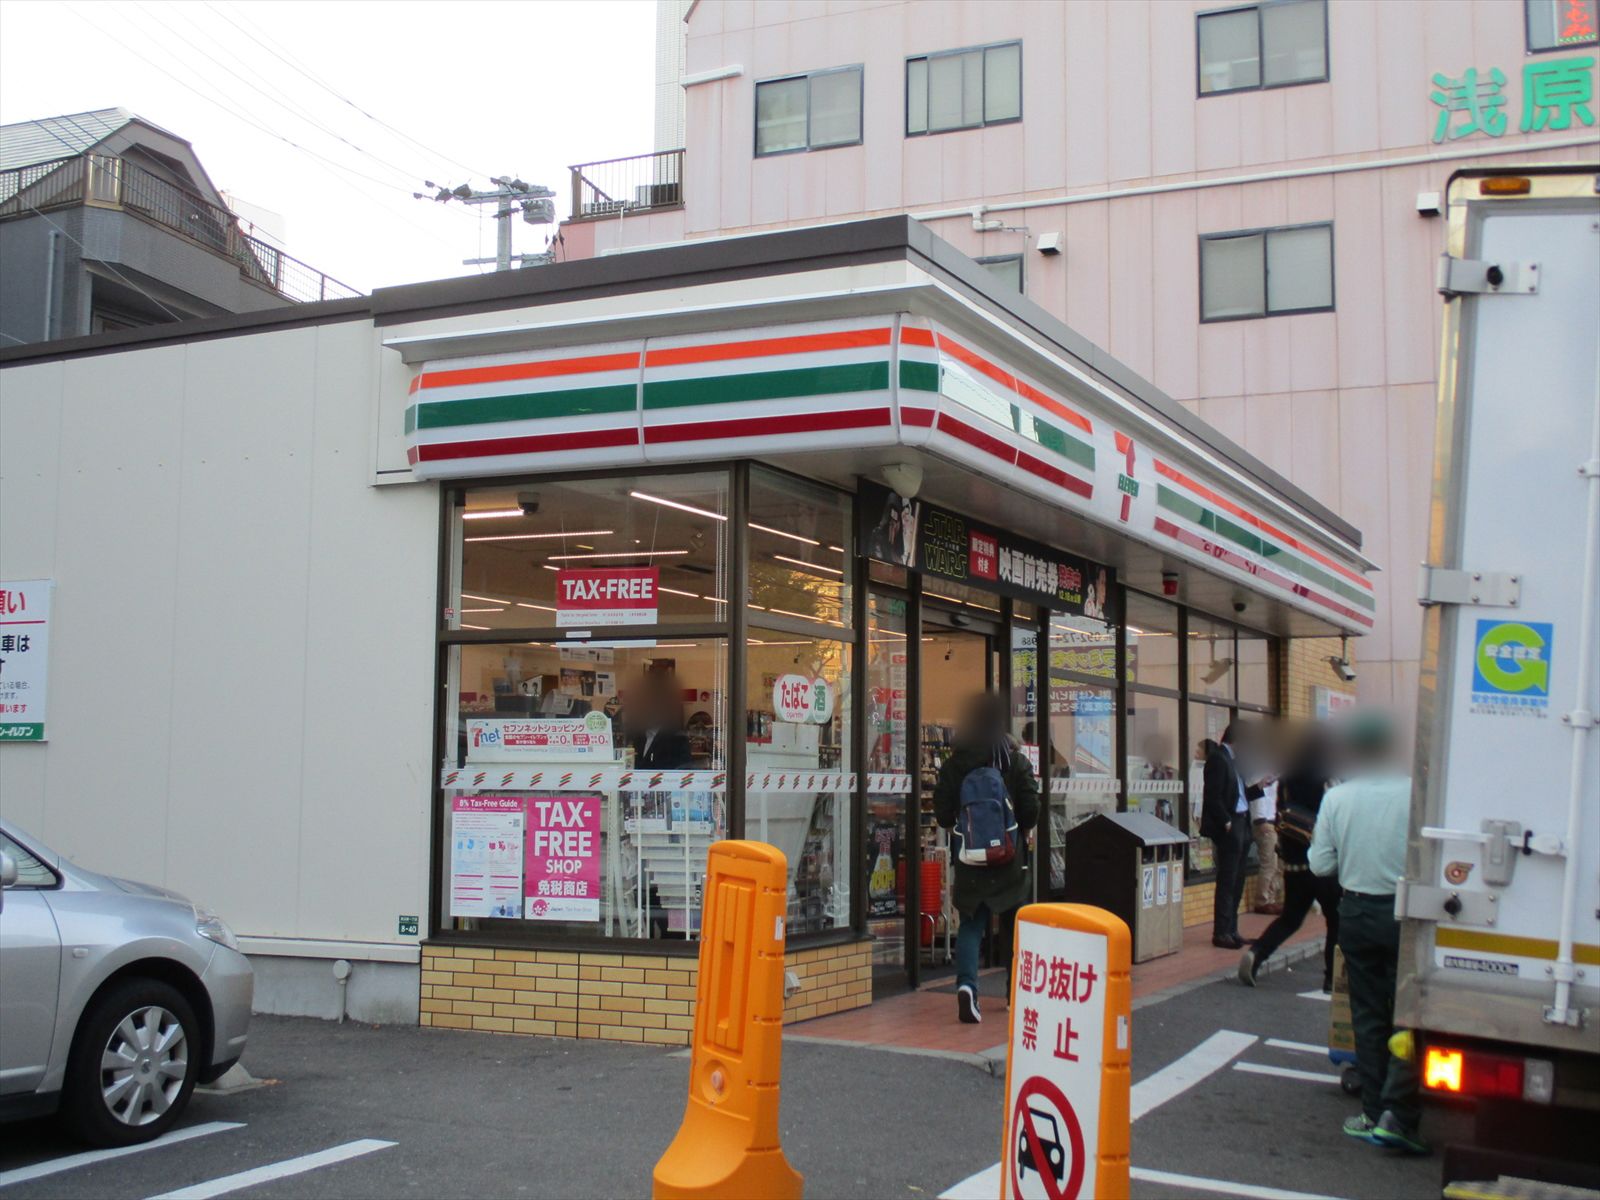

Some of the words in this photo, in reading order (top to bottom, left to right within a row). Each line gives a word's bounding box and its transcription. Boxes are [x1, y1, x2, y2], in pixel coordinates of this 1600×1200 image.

[1429, 56, 1595, 145] 浅原
[924, 510, 968, 546] STAR
[924, 542, 968, 579] WARS
[999, 546, 1058, 596] 映画前売券
[562, 578, 654, 600] TAX-FREE
[781, 681, 809, 710] たばこ
[814, 684, 826, 712] 酒
[471, 800, 498, 808] Tax-Free
[499, 800, 518, 808] Guide
[535, 801, 592, 828] TAX-
[534, 831, 592, 857] FREE
[546, 859, 582, 874] SHOP
[538, 880, 588, 896] 免税商店
[1018, 950, 1098, 1004] 通り抜け
